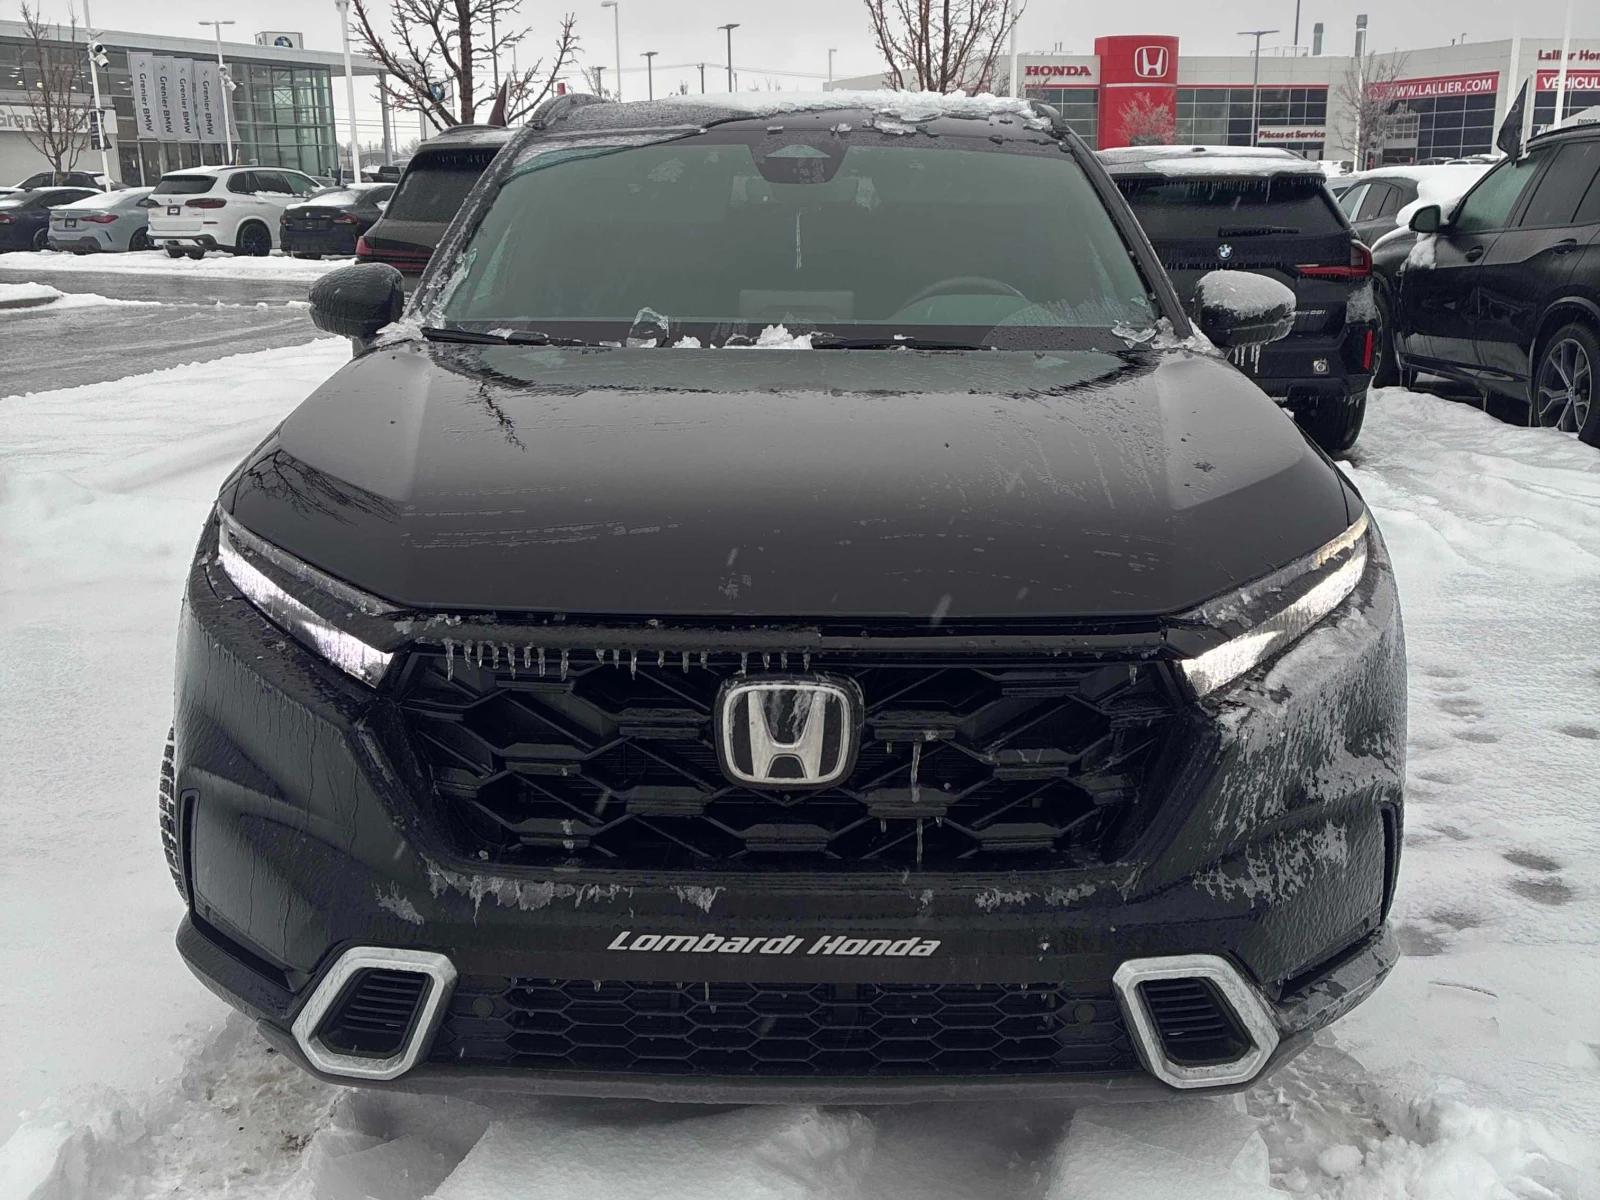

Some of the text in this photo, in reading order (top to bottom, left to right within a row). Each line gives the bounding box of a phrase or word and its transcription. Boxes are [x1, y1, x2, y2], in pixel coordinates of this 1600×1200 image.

[1025, 65, 1092, 76] HONDA
[139, 72, 154, 132] Grenier BMW
[159, 76, 174, 134] Grenier BMW
[179, 78, 191, 134] Grenier BMW
[202, 80, 215, 135] Grenier BMW
[1259, 130, 1284, 139] Pièces
[1295, 130, 1326, 138] Service
[606, 931, 942, 957] Lombardi Honda
